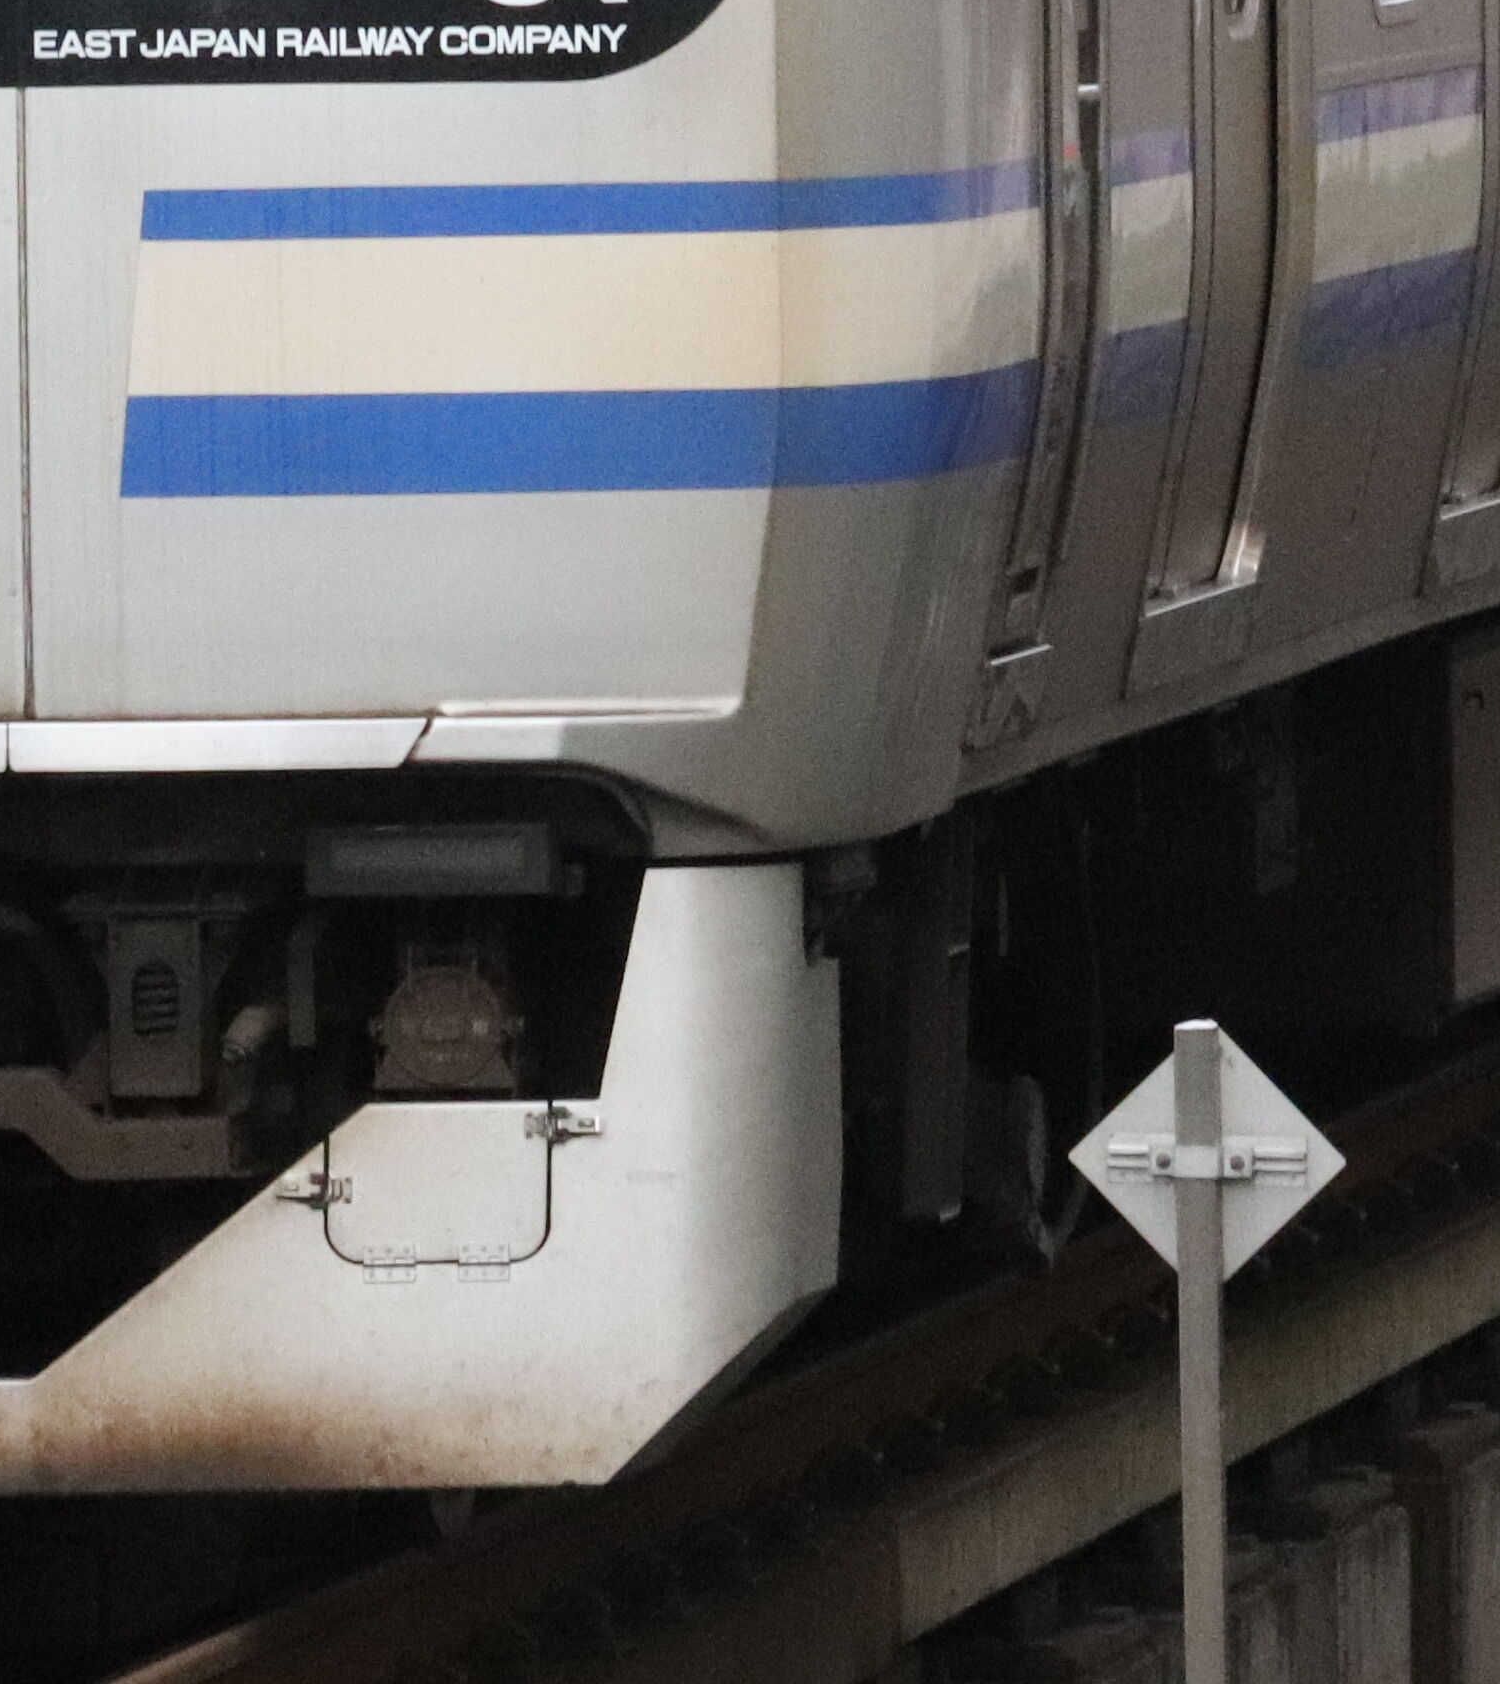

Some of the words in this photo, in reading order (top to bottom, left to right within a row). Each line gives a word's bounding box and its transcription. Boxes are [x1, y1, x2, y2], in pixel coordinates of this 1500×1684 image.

[33, 29, 137, 60] EAST
[140, 27, 266, 59] JAPAN
[276, 25, 435, 58] RAILWAY
[439, 23, 628, 56] COMPANY
